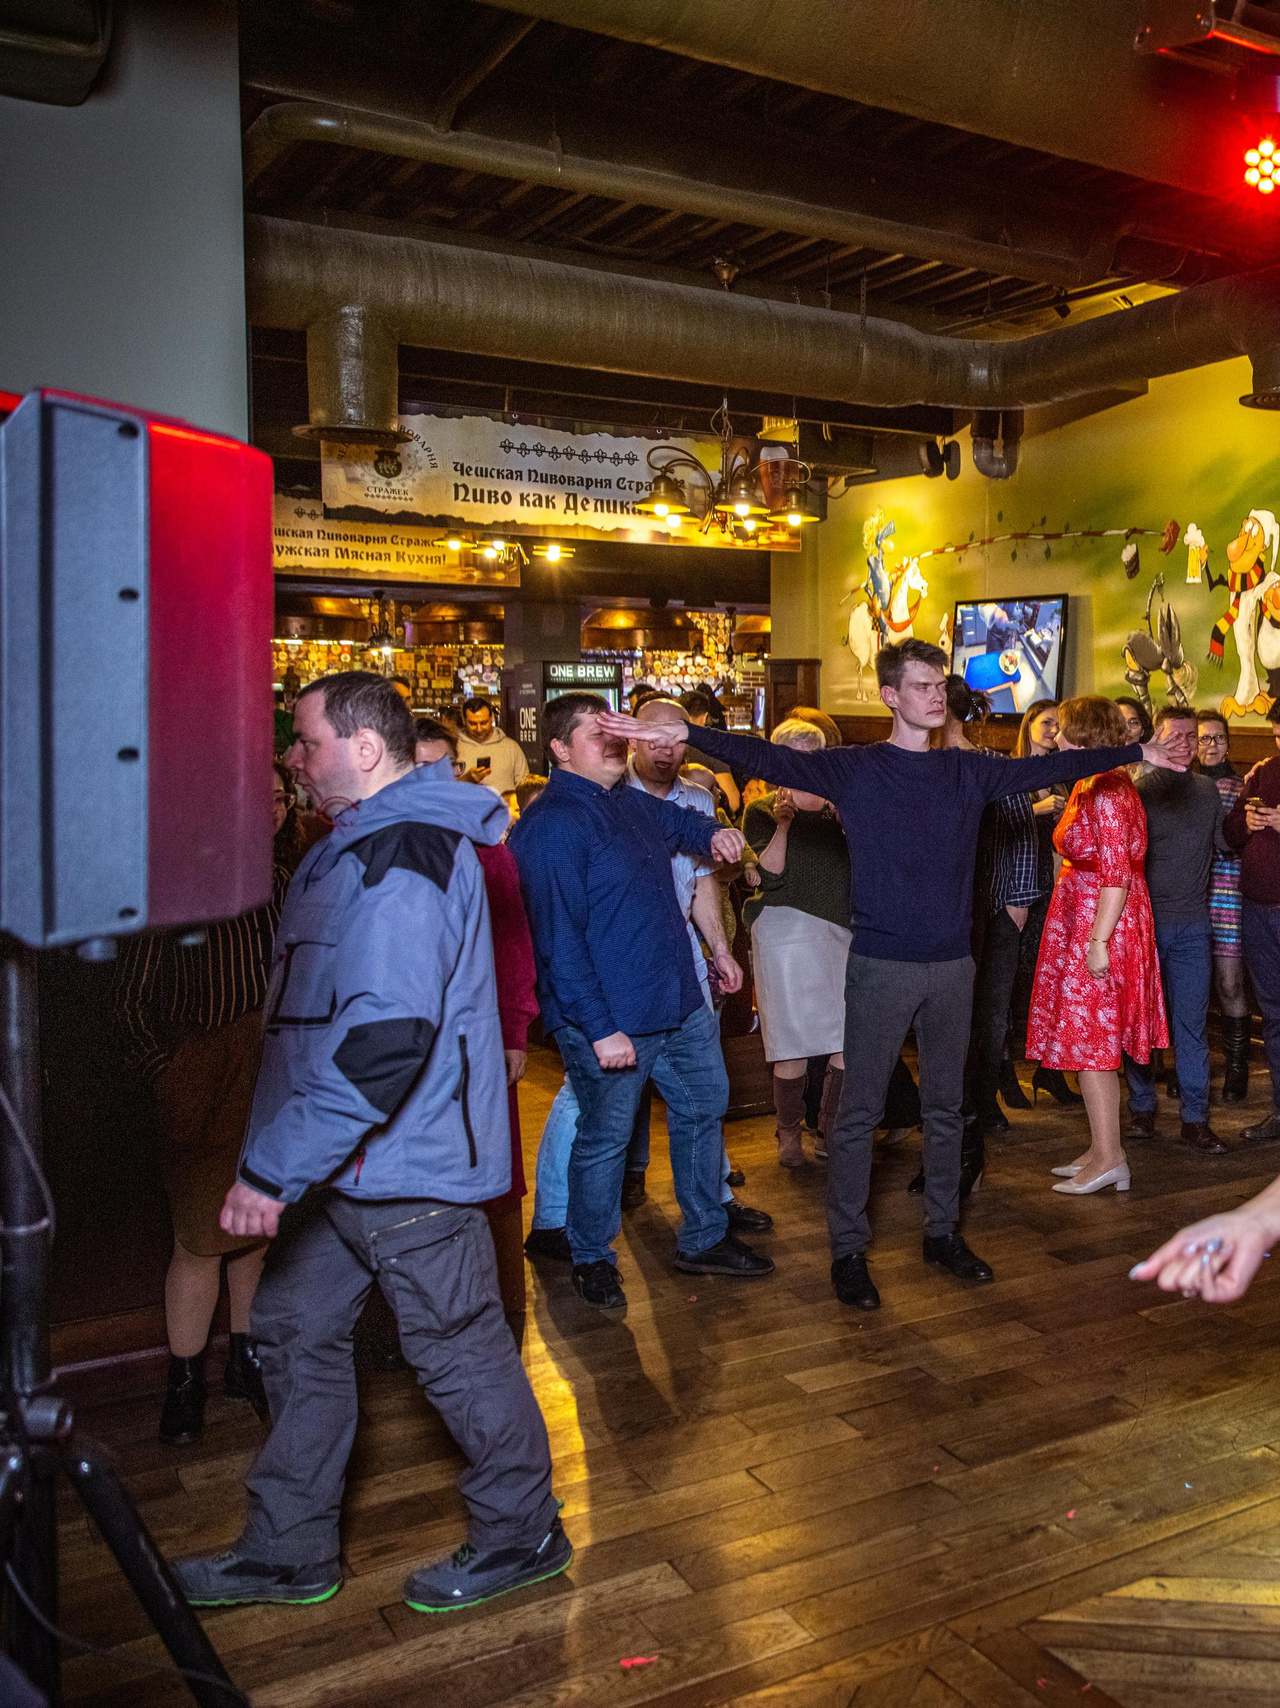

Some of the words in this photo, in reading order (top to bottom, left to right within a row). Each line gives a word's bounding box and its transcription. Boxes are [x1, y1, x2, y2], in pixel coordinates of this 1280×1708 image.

[400, 424, 439, 469] ВОВАРНЯ
[452, 461, 523, 482] Чешская
[527, 468, 613, 491] Пивоварня
[616, 477, 653, 494] Стра
[366, 486, 409, 496] СТРАЖЕК
[453, 482, 512, 505] Пиво
[519, 491, 556, 510] как
[563, 492, 648, 516] Делика
[274, 527, 313, 539] шская
[316, 529, 387, 546] Пивоварня
[274, 543, 330, 558] ужская
[335, 546, 391, 562] Мясная
[395, 551, 446, 566] Кухня!
[549, 665, 573, 677] ONE
[577, 665, 615, 678] BREW
[519, 707, 537, 729] ONE
[520, 730, 537, 742] BREW
